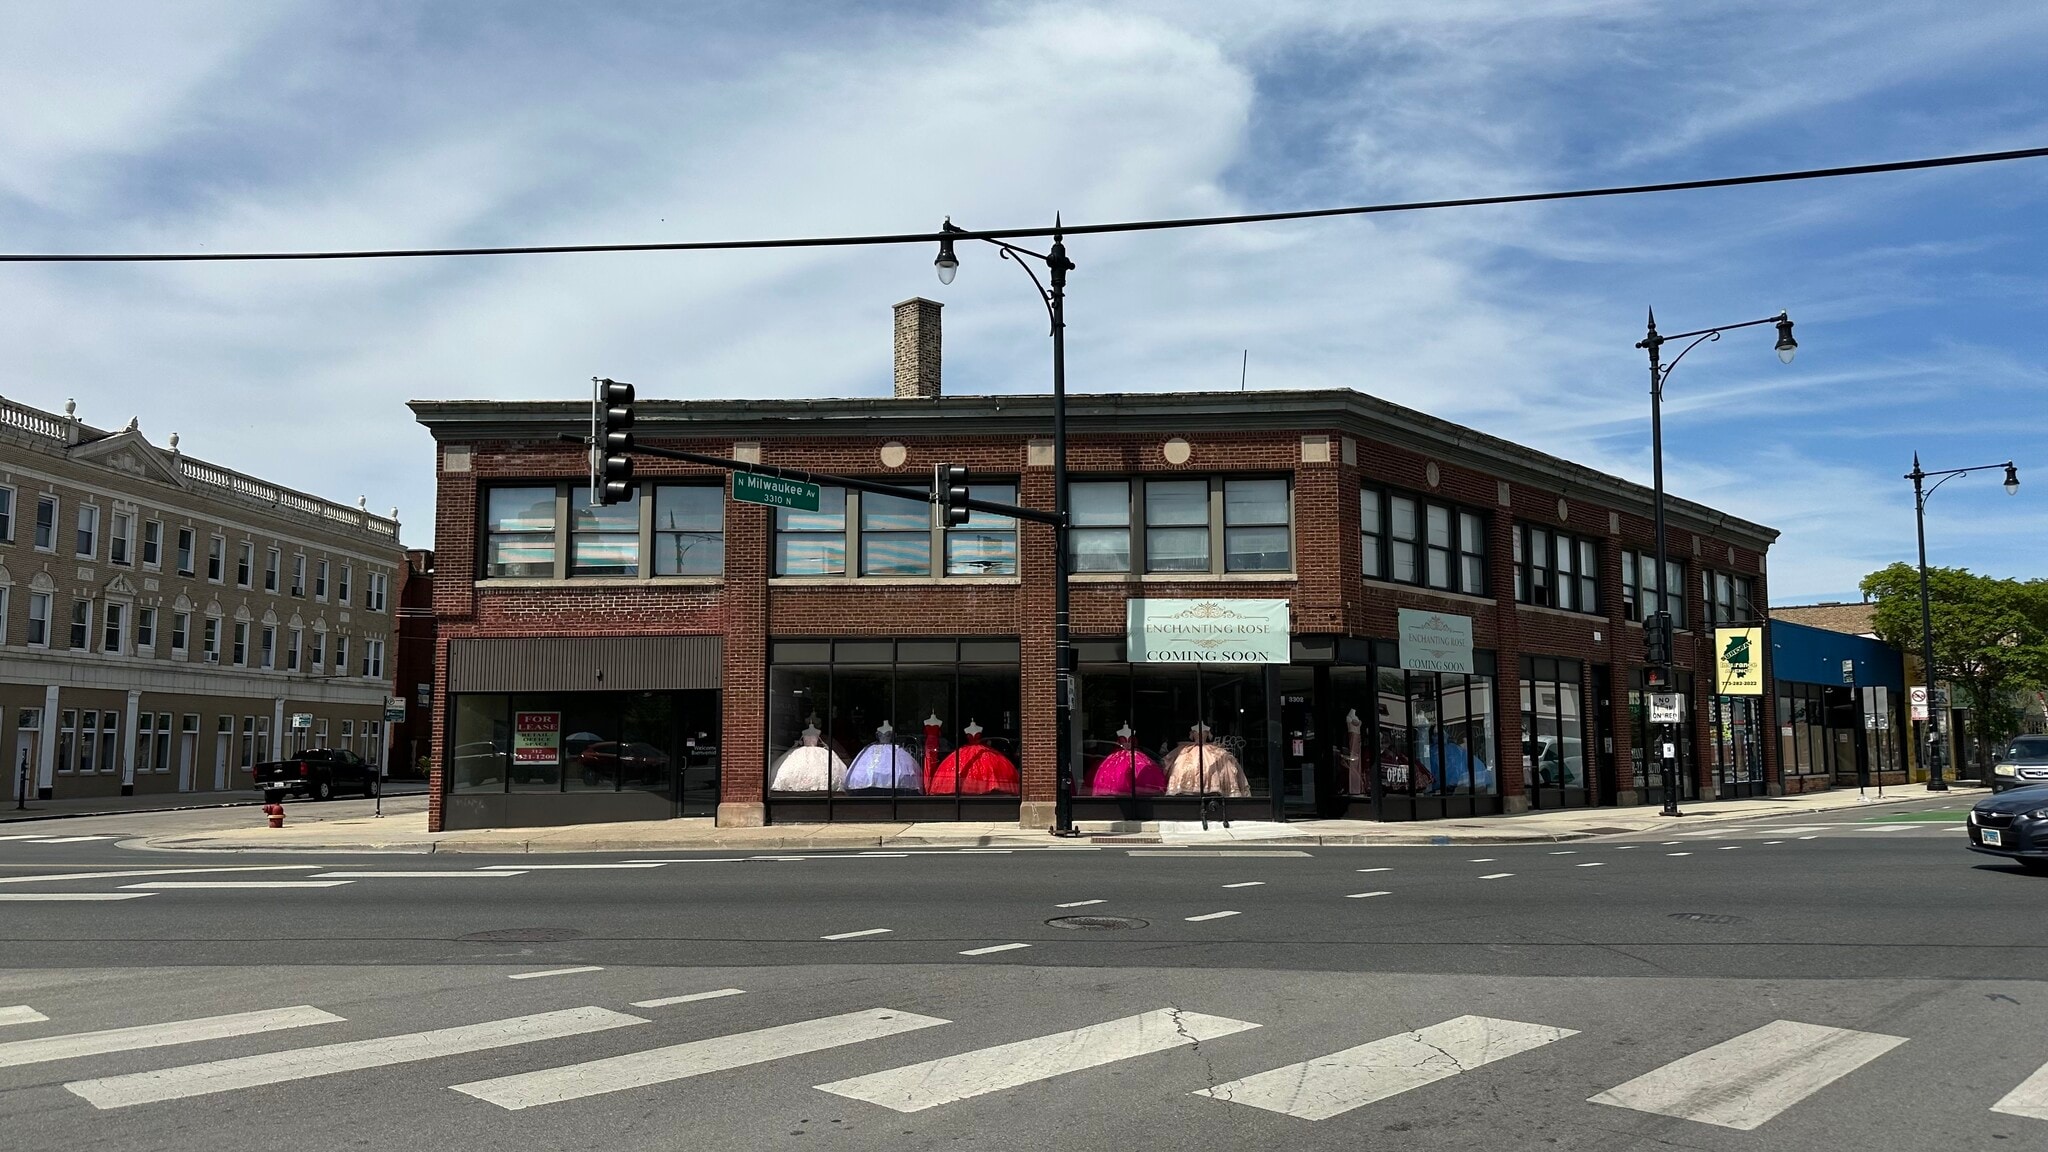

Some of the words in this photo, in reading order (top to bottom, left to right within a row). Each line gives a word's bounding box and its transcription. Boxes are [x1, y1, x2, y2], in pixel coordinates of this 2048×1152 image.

[738, 478, 744, 486] N
[747, 476, 803, 496] Milwaukee
[806, 489, 816, 498] Av
[764, 493, 783, 504] 3310
[785, 497, 792, 505] N
[1146, 624, 1233, 634] ENCHANTING
[1237, 624, 1270, 634] ROSE
[1408, 633, 1449, 646] ENCHANTING
[1147, 650, 1217, 662] COMING
[1220, 650, 1269, 662] SOON
[1408, 658, 1441, 670] COMING
[1443, 661, 1465, 672] SOON
[524, 715, 552, 723] FOR
[1386, 766, 1408, 783] OPEN
